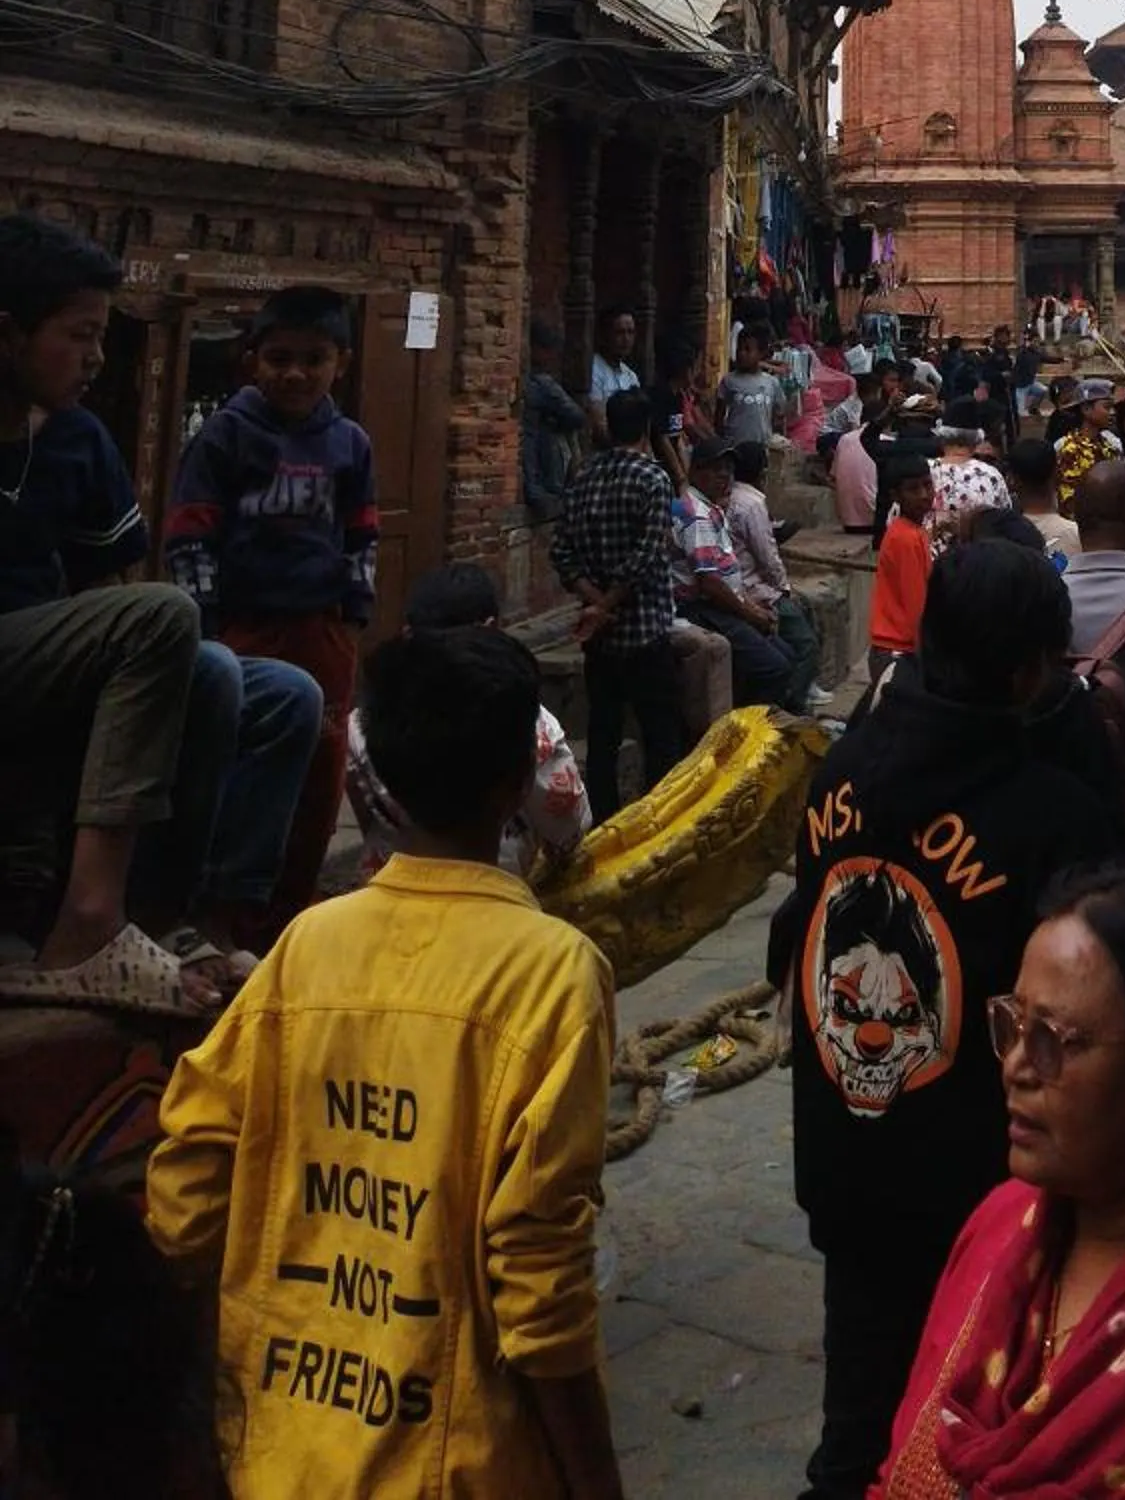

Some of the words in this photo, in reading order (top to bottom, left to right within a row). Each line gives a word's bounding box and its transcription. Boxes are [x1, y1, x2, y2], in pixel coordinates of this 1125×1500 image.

[911, 811, 1008, 901] OW
[305, 1161, 431, 1242] MONEY
[330, 1254, 393, 1325] NOT
